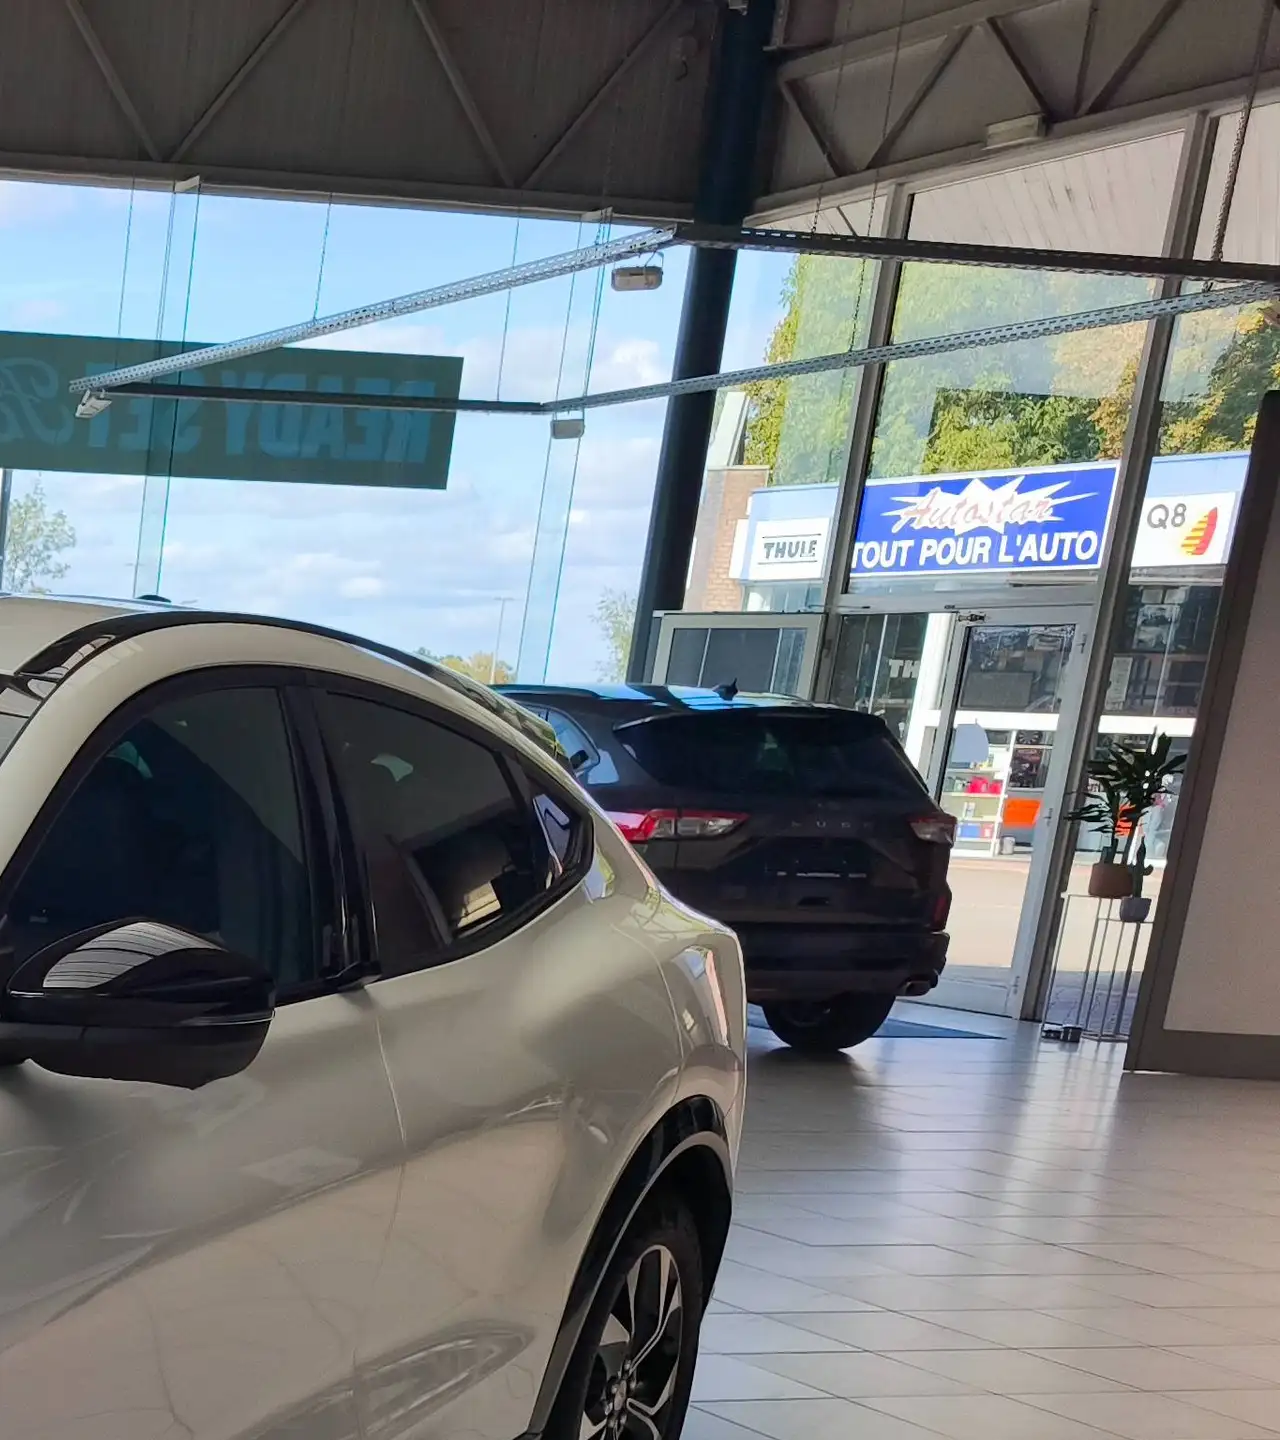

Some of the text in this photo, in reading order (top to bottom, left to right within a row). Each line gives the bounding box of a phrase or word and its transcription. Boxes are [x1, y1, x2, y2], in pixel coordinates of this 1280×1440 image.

[895, 487, 1052, 531] Autostar
[1147, 502, 1186, 530] Q8
[763, 539, 818, 560] THULE
[851, 529, 1099, 570] TOUT POUR L'AUTO
